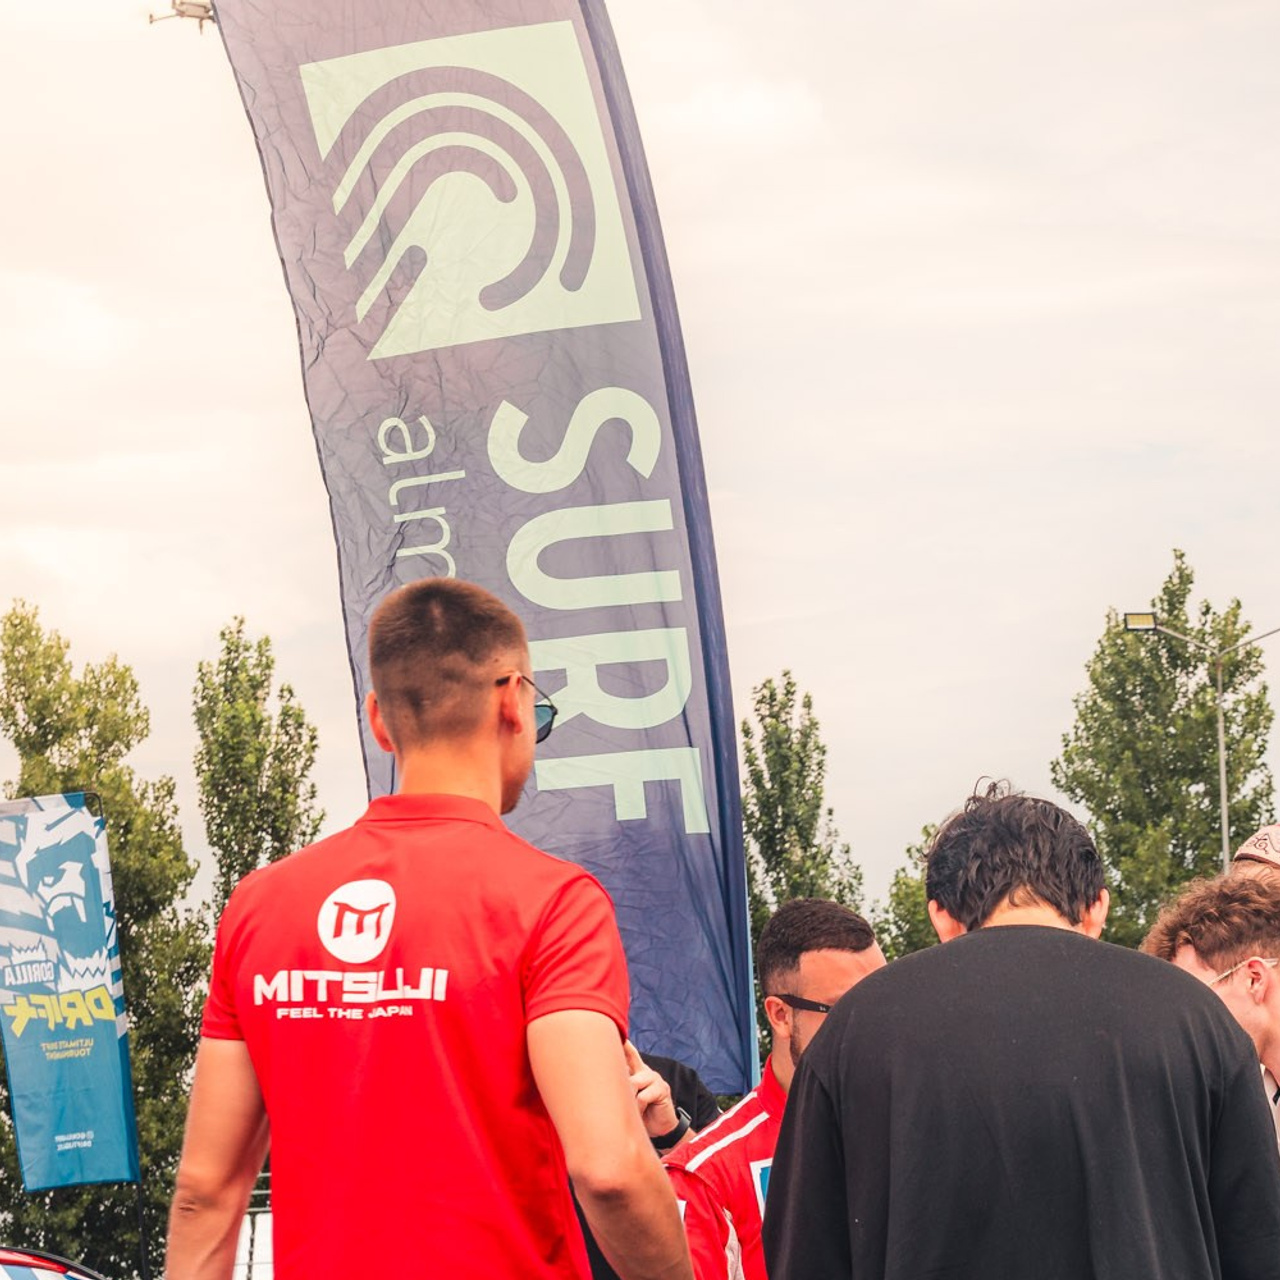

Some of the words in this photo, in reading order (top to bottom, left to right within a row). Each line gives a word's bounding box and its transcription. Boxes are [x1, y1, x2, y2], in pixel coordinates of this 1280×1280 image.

[377, 415, 466, 580] alm
[487, 385, 711, 835] SURF
[276, 1007, 324, 1020] FEEL
[327, 1007, 364, 1020] THE
[368, 1005, 413, 1019] JAPAN
